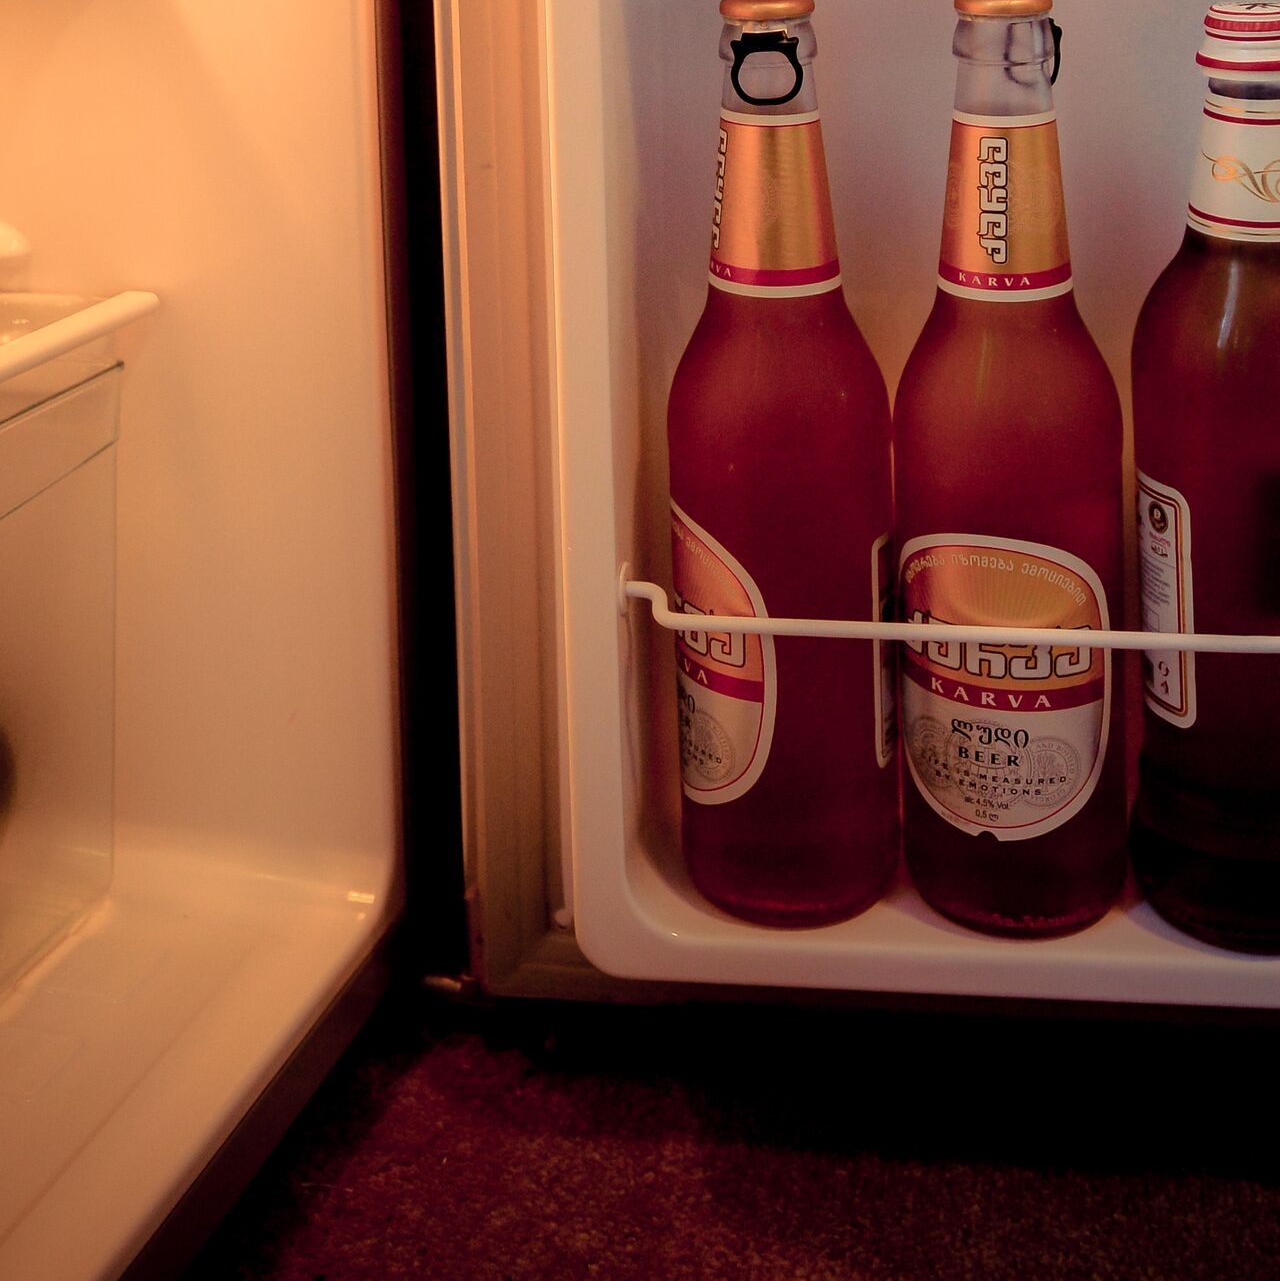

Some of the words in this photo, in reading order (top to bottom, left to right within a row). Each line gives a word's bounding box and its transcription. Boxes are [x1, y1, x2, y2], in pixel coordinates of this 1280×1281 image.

[958, 271, 1031, 287] KARVA
[930, 676, 1052, 709] KARVA
[951, 718, 1030, 750] ლუდი
[958, 746, 1021, 767] BEER
[959, 778, 1041, 796] EMOTIONS
[979, 773, 1067, 785] MEASURED
[964, 796, 975, 806] alc
